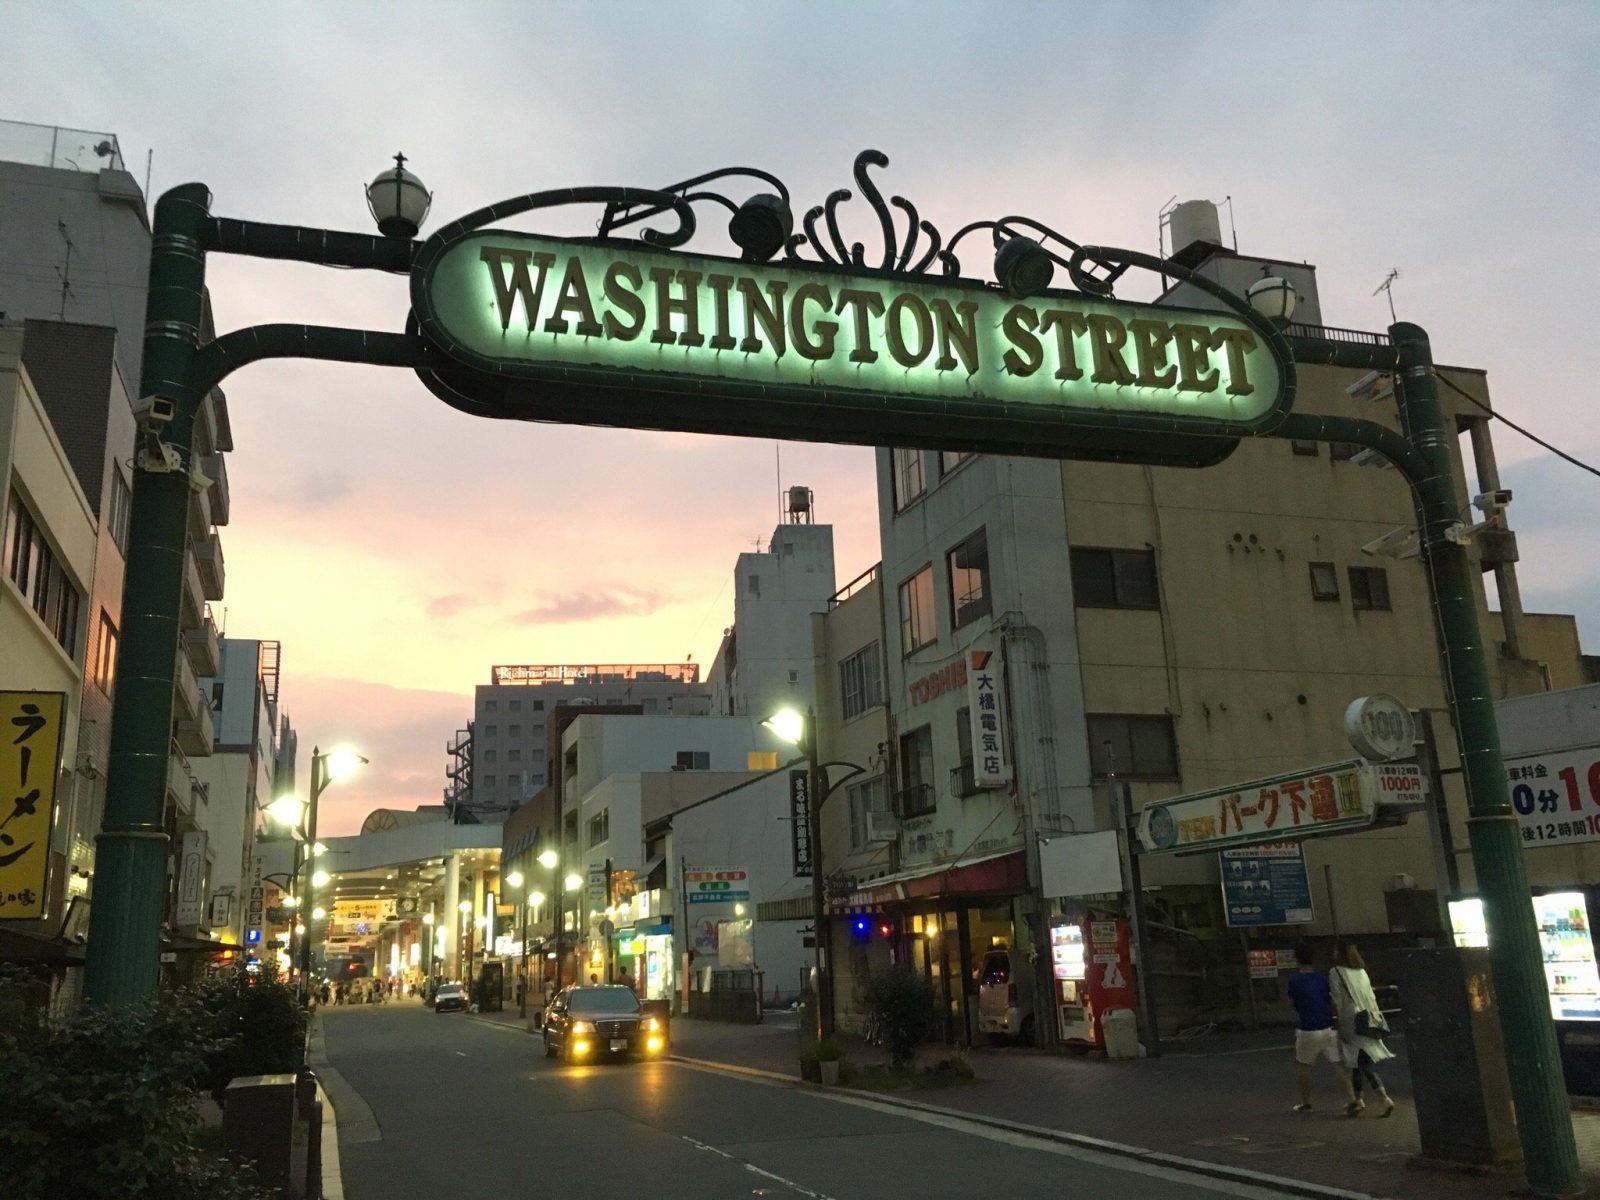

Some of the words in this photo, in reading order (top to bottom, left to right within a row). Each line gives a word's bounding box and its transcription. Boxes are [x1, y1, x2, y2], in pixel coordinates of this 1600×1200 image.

[480, 247, 980, 377] WASHINGTON
[1001, 304, 1257, 396] STREET
[497, 666, 553, 680] Richmond
[558, 665, 586, 679] Hotel
[909, 658, 967, 707] TOSHIB
[977, 674, 1000, 774] 大橋電気店
[0, 704, 46, 867] ラーメン
[1380, 775, 1421, 791] 1000円
[1504, 763, 1548, 781] 車料金
